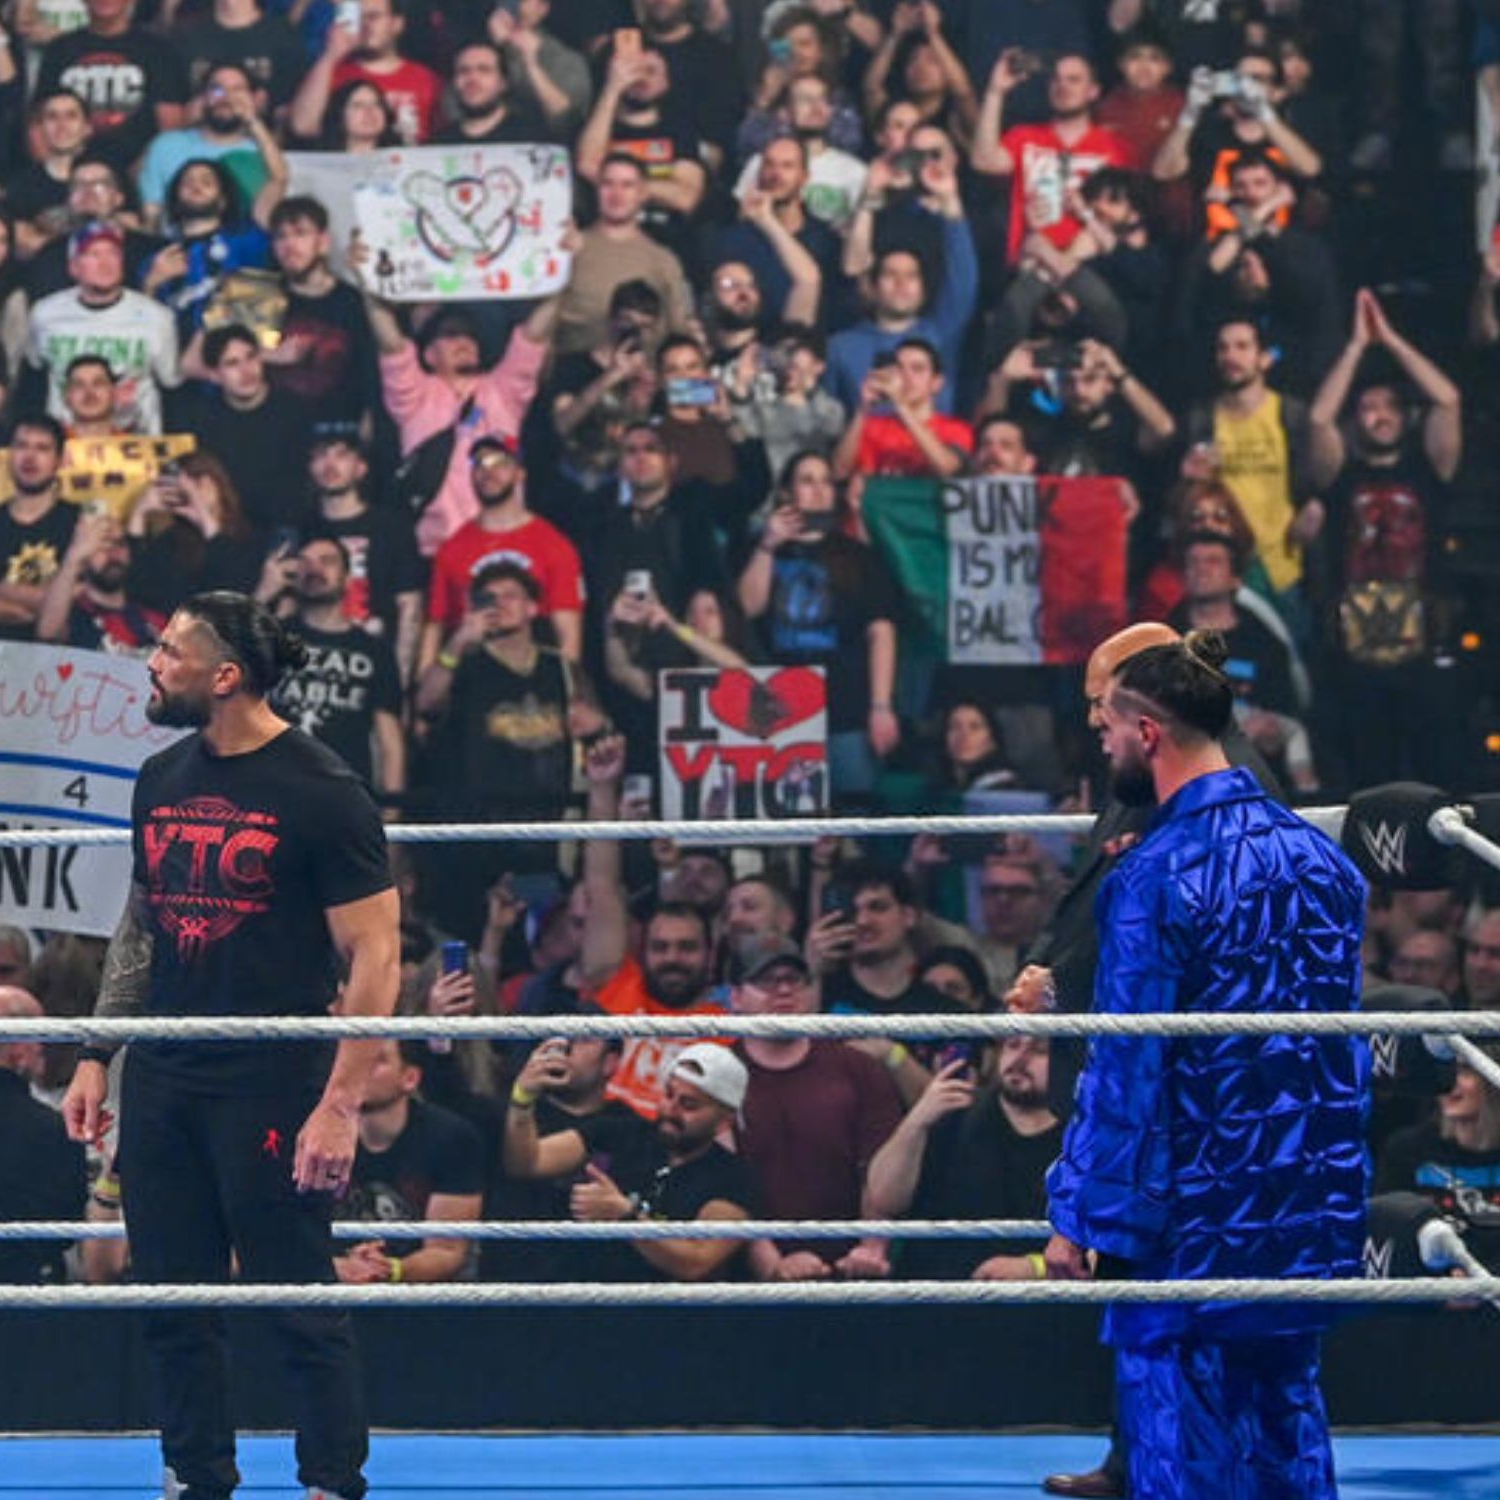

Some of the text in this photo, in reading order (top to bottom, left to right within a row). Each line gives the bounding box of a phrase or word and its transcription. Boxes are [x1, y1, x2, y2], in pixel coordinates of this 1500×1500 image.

[937, 482, 1066, 537] PUNK
[958, 541, 996, 589] IS
[664, 674, 721, 742] I
[63, 774, 90, 808] 4
[142, 822, 280, 899] YTC
